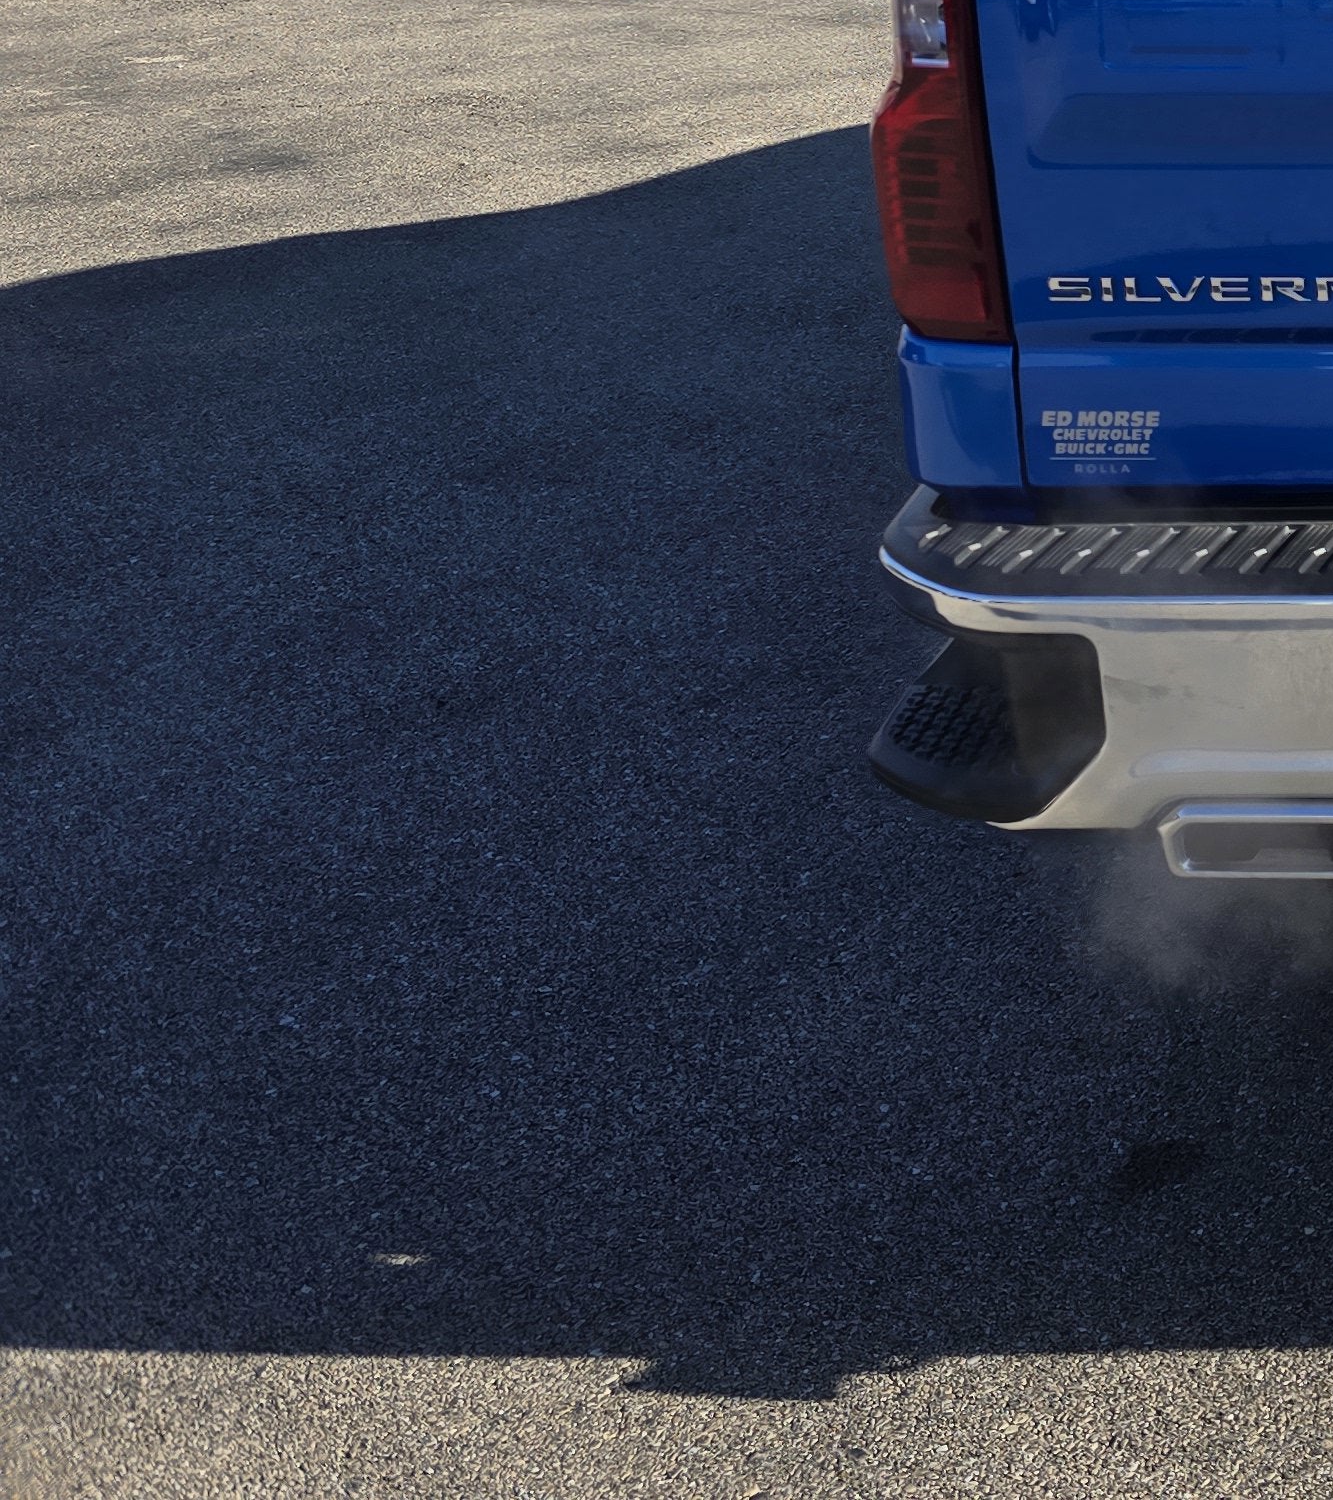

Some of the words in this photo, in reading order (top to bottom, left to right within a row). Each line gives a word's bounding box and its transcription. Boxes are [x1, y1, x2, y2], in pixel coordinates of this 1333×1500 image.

[1041, 410, 1073, 427] ED
[1077, 410, 1161, 428] MORSE
[1052, 428, 1153, 441] CHEVROLET
[1074, 463, 1131, 474] ROLLA
